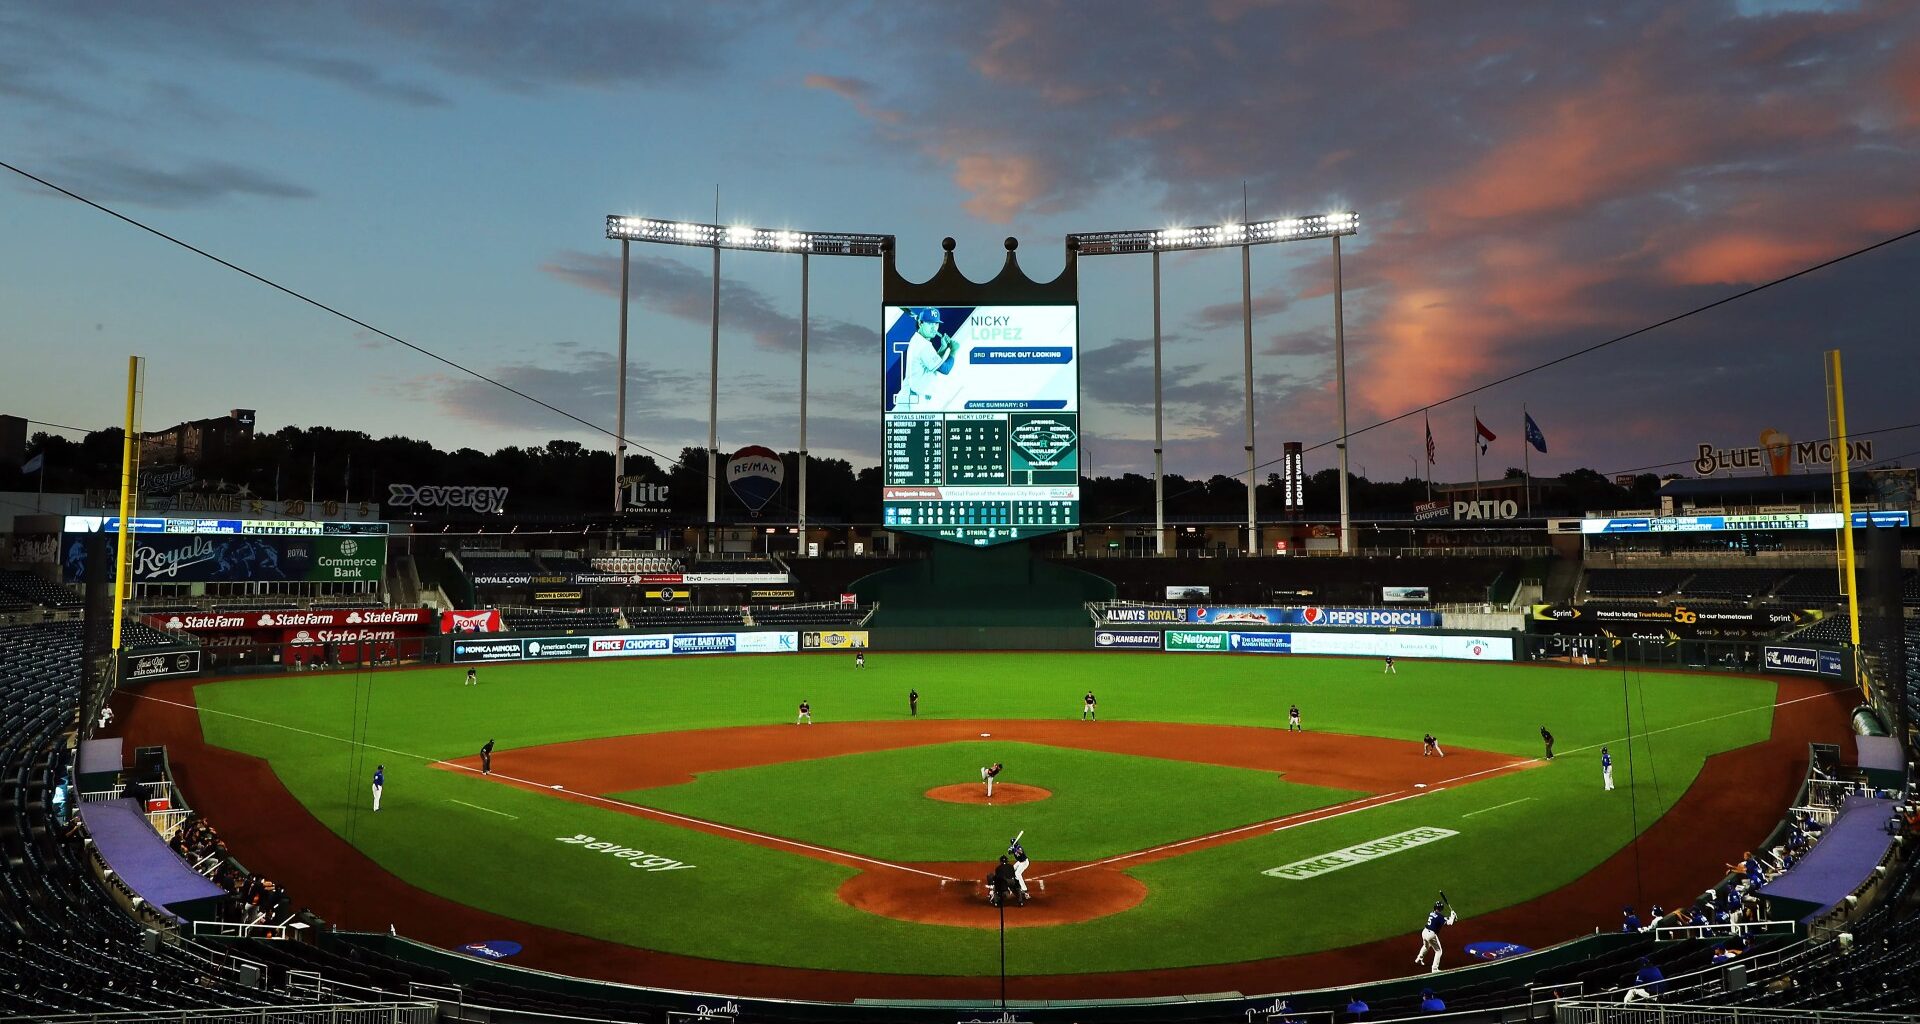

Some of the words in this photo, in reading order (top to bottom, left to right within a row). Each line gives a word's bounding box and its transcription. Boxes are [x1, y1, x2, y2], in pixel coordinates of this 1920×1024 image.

[971, 316, 1010, 326] NICKY
[971, 328, 1023, 340] LOPEZ
[1695, 442, 1762, 476] BLUE
[734, 461, 778, 476] RE/MAX
[1296, 453, 1304, 506] BOULEVARD
[418, 486, 508, 513] evergy
[629, 482, 670, 507] Lite
[177, 491, 242, 512] FAME
[285, 501, 305, 517] 20
[322, 501, 338, 516] 10
[359, 501, 369, 517] 5
[1415, 501, 1437, 513] PRICE
[1453, 499, 1518, 521] PATIO
[1415, 508, 1450, 522] CHOPPER
[956, 528, 963, 538] 2
[988, 528, 996, 538] 2
[1010, 528, 1018, 538] 2
[134, 535, 216, 579] Royals
[287, 549, 308, 558] ROYAL
[318, 556, 377, 567] Commerce
[334, 567, 362, 577] Bank
[474, 576, 567, 584] ROYALS.COM/THEKEEP
[577, 576, 628, 584] PrimeLending
[275, 614, 304, 626] State
[304, 614, 333, 624] Farm
[363, 612, 391, 623] State
[392, 612, 418, 622] Farm
[1106, 610, 1145, 621] ALWAYS
[1148, 610, 1178, 621] ROYAL
[1330, 612, 1367, 624] PEPSI
[1371, 612, 1421, 625] PORCH
[1552, 610, 1572, 619] Sprint
[1674, 607, 1696, 624] 5G
[1769, 614, 1791, 623] Sprint
[184, 616, 214, 628] State
[214, 616, 245, 627] Farm
[456, 619, 486, 628] SONIC
[316, 630, 356, 646] State
[358, 629, 396, 644] Farm
[673, 637, 697, 647] SWEET
[698, 636, 717, 646] BABY
[717, 636, 735, 646] RAY'S
[779, 634, 794, 645] KC
[1115, 635, 1142, 643] KANSAS
[1183, 634, 1222, 644] National
[595, 641, 621, 650] PRICE
[626, 640, 666, 650] CHOPPER
[1783, 654, 1816, 666] MOLottery
[584, 842, 696, 872] evergy
[1278, 856, 1353, 878] PRICE
[1350, 828, 1444, 857] CHOPPER
[1427, 916, 1433, 926] 5
[697, 1002, 740, 1020] Royals
